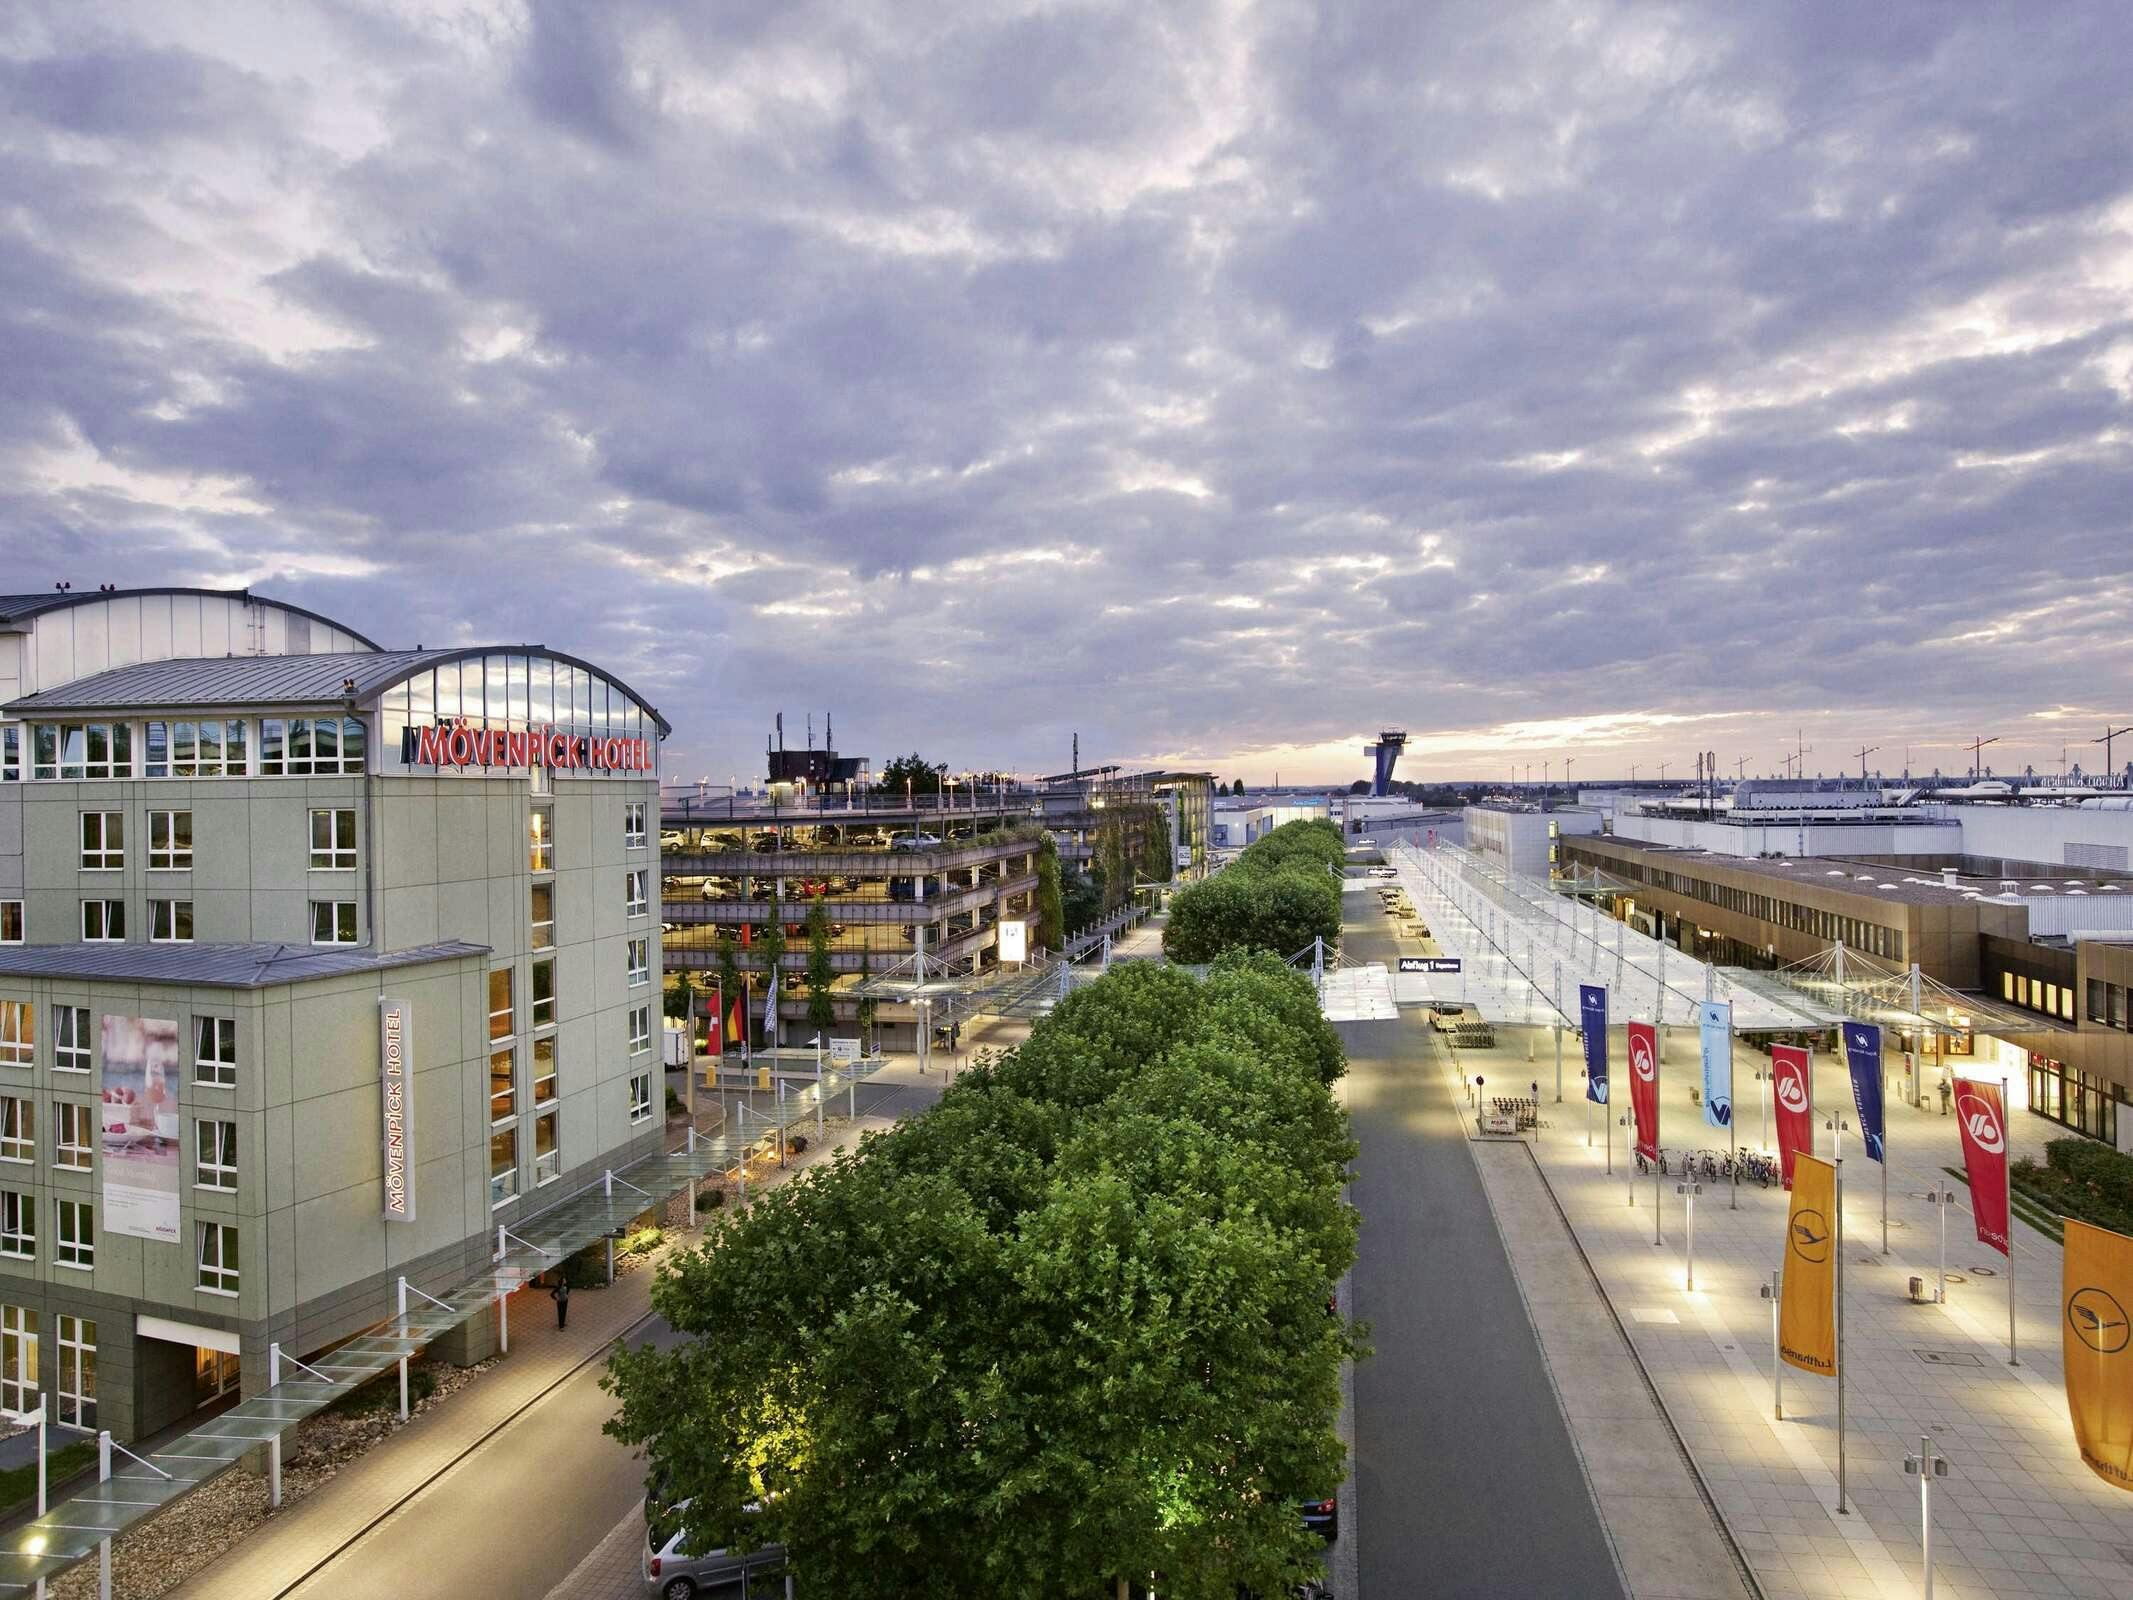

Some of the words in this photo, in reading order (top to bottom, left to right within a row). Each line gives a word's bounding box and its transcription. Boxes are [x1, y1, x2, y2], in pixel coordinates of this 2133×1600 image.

[417, 717, 583, 768] MÖVENPICK
[590, 736, 652, 770] HOTEL
[1400, 960, 1428, 972] Abflug
[1430, 961, 1435, 970] 1
[386, 1007, 401, 1077] HOTEL
[385, 1081, 405, 1214] MÖVENPICK
